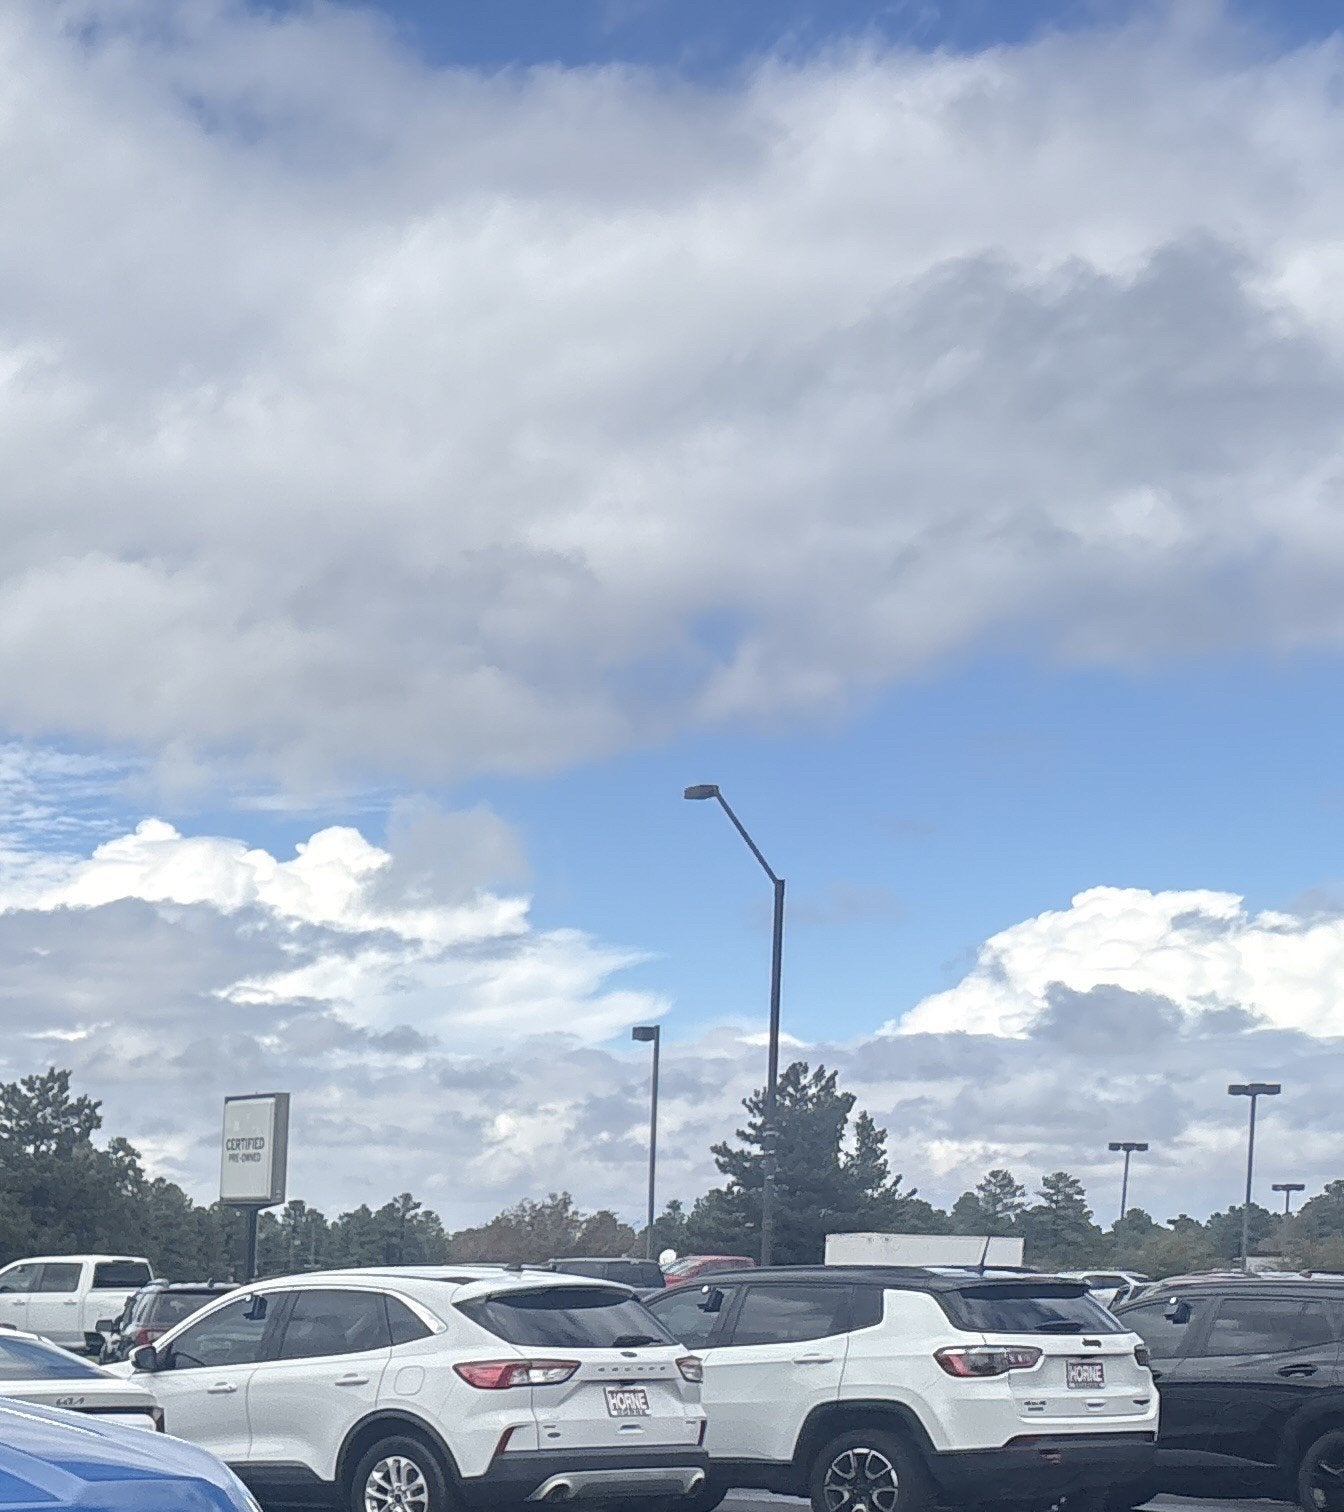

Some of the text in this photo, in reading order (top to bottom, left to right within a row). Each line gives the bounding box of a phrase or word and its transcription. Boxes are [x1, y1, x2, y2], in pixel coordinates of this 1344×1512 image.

[226, 1136, 265, 1151] CERTIFIED
[228, 1152, 261, 1163] PRE-OWNED
[608, 1392, 648, 1410] HORNE
